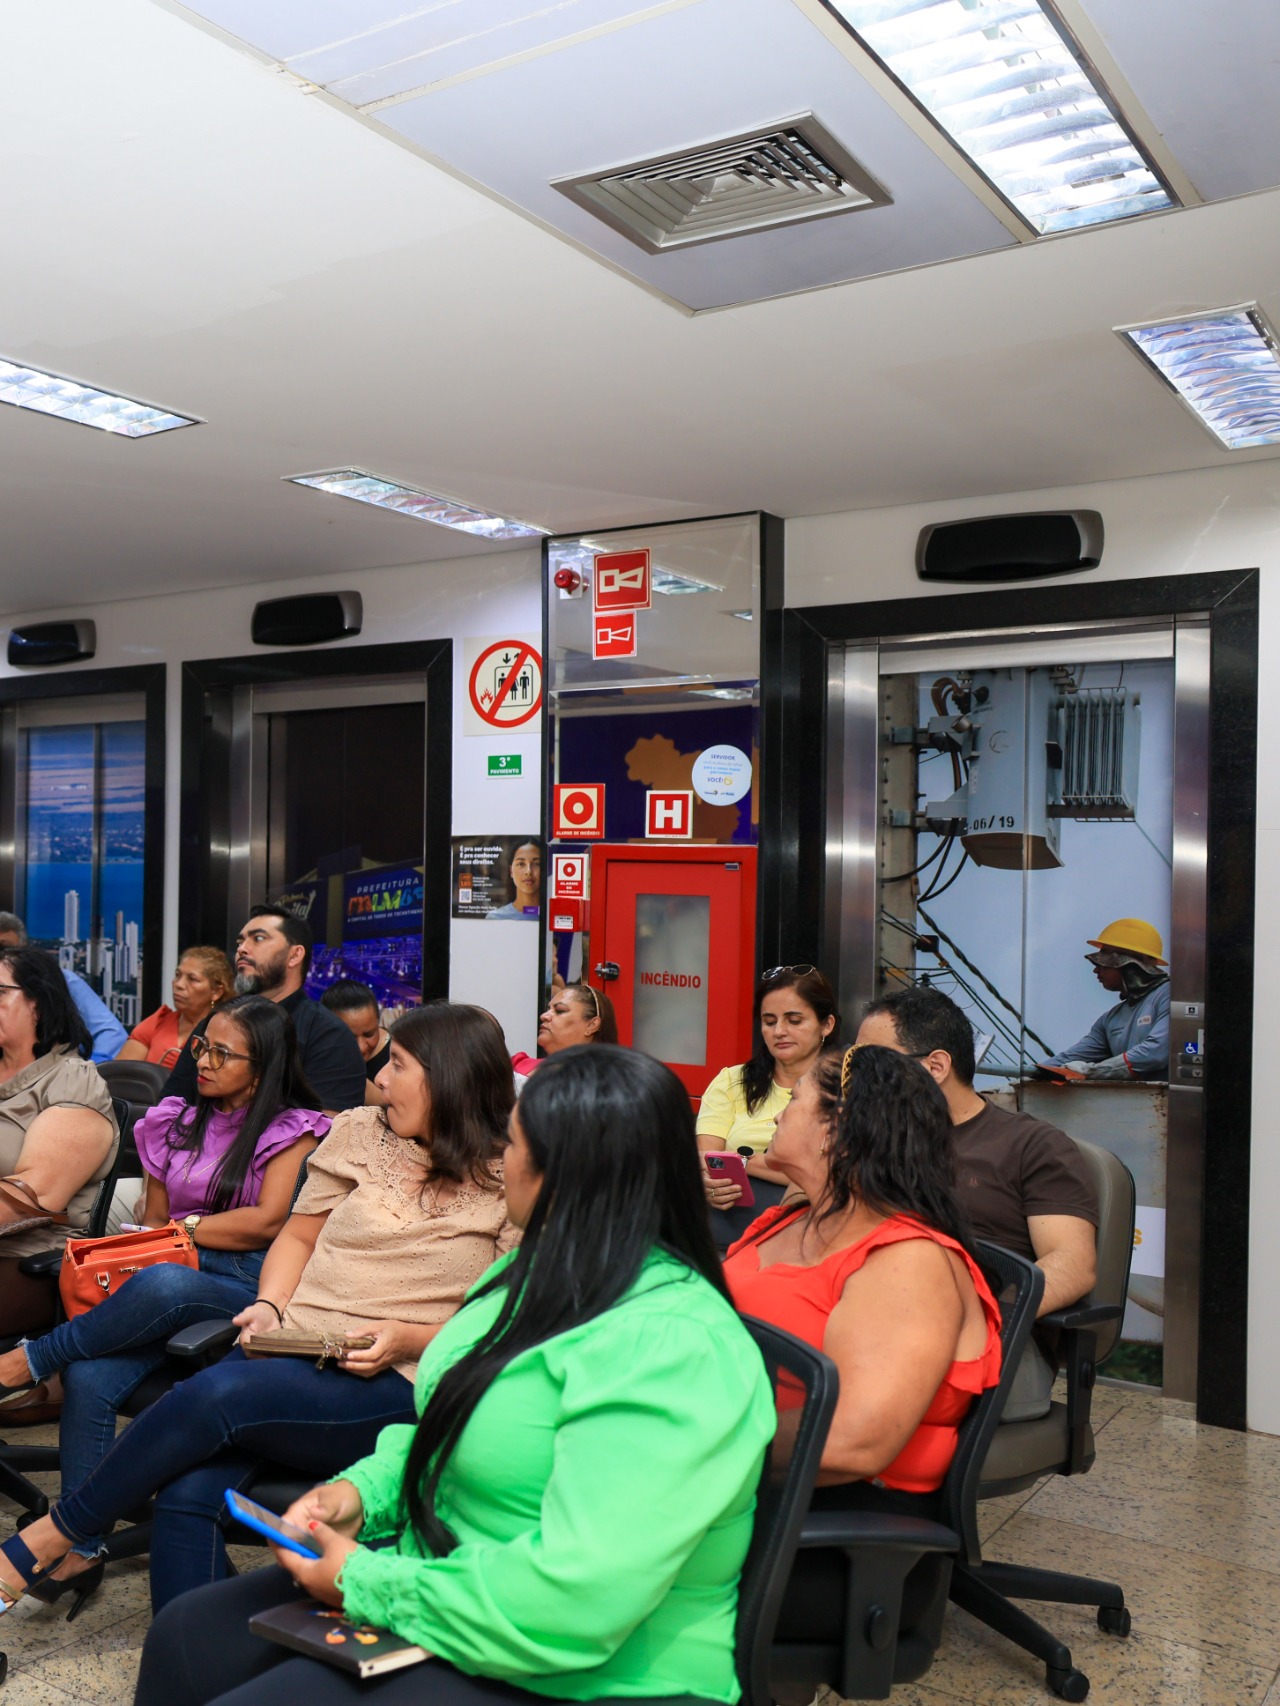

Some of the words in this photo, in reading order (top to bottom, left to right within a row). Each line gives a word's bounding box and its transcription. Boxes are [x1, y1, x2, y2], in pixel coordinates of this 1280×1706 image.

[654, 799, 683, 829] H
[356, 877, 419, 895] PREFEITURA
[640, 970, 702, 989] INCÊNDIO
